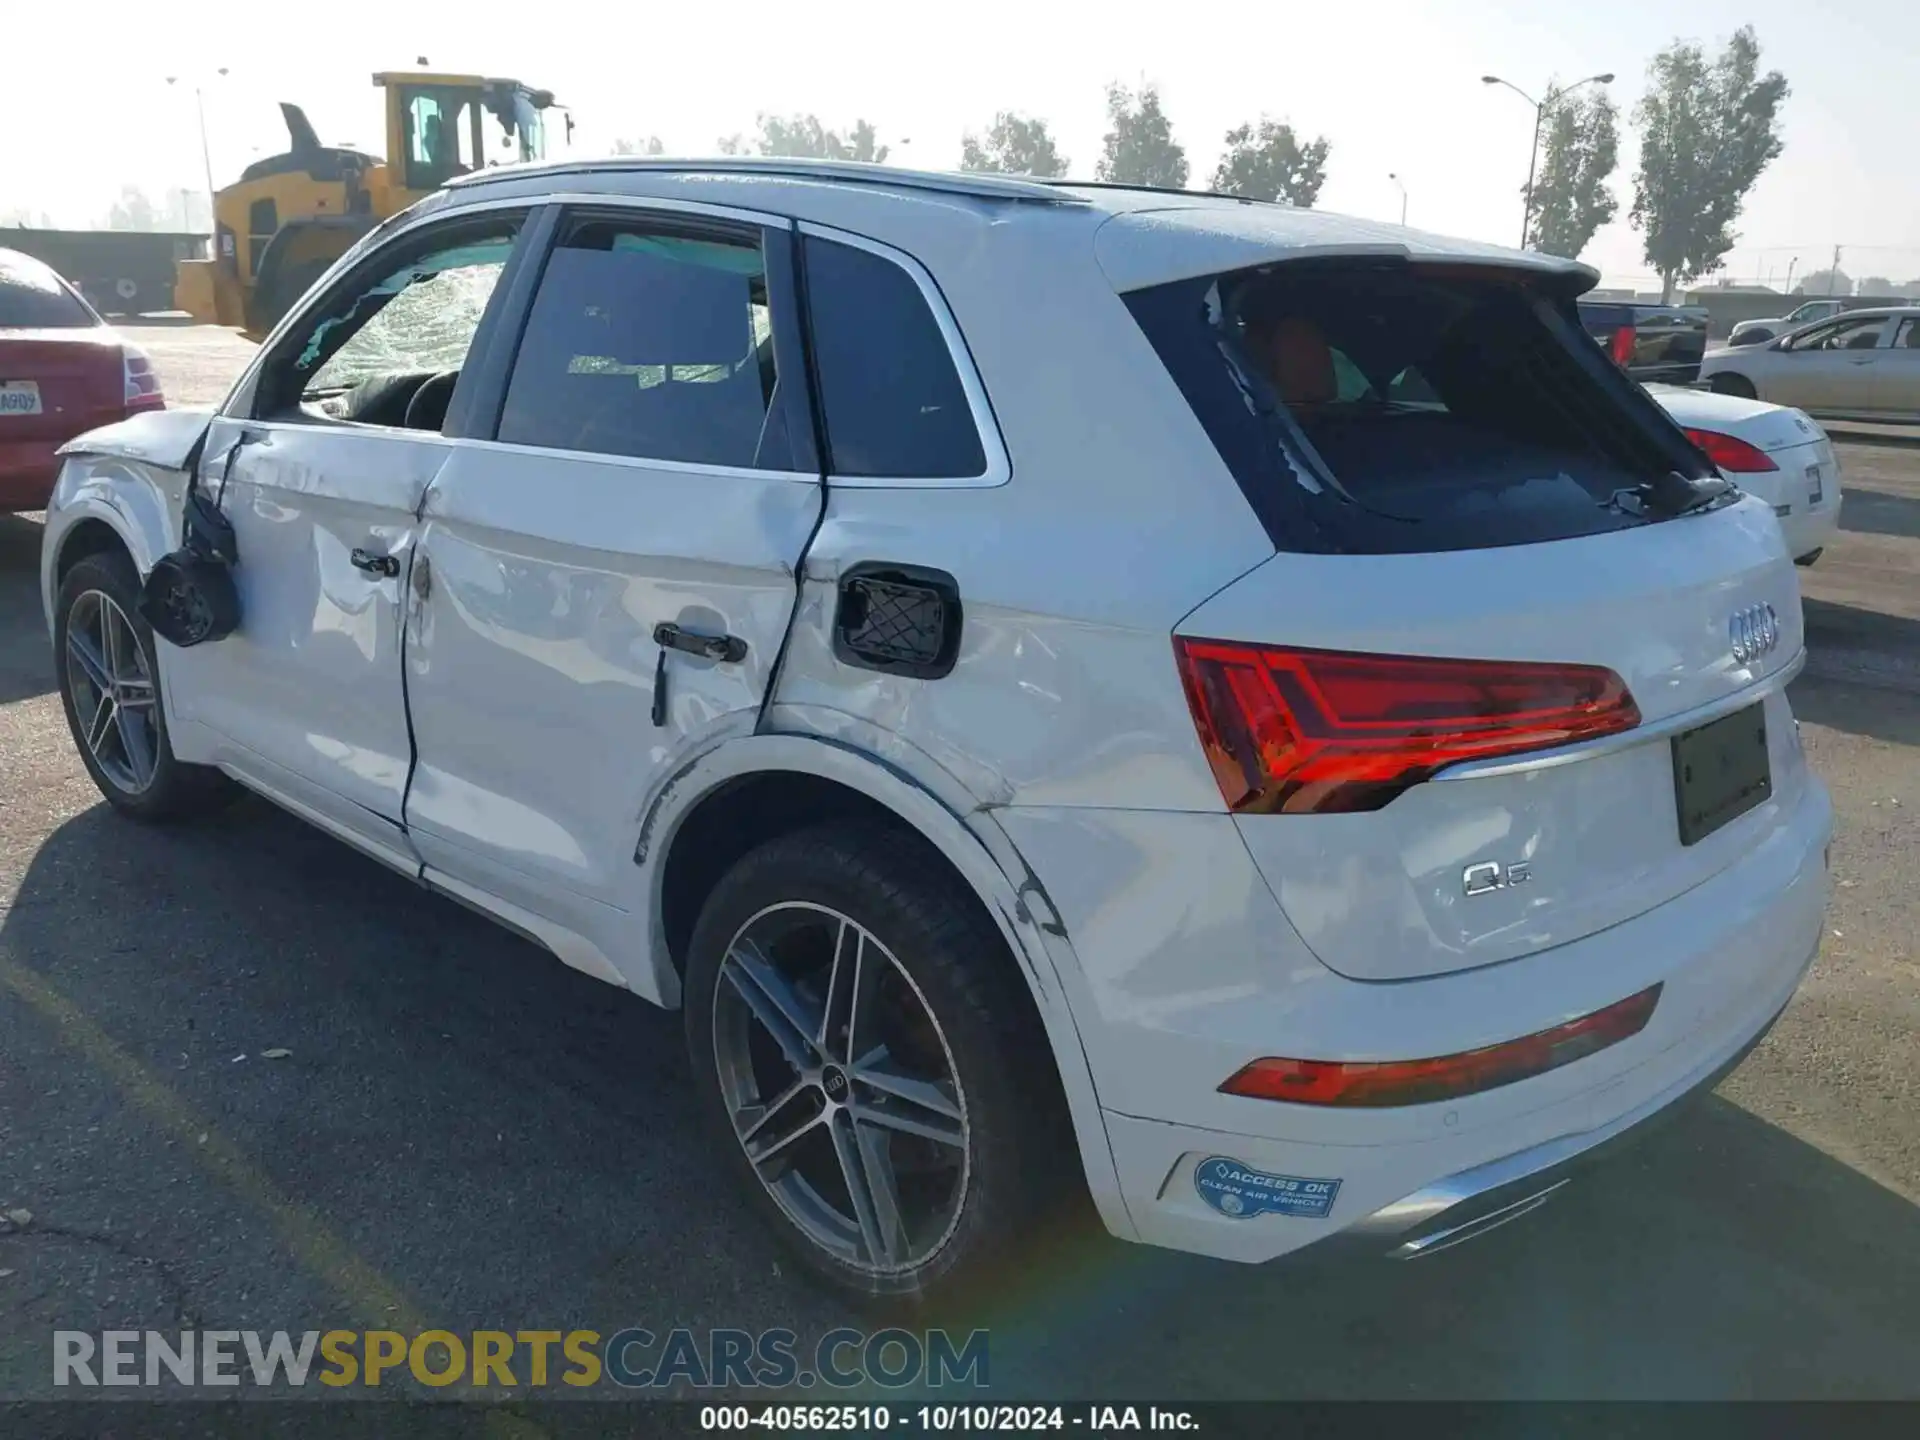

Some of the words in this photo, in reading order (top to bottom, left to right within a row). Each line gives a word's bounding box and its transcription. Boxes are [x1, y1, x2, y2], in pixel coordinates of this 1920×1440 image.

[1463, 861, 1532, 895] Q5
[1201, 1179, 1242, 1194] CLEAN
[1245, 1191, 1268, 1201] AIR
[1273, 1195, 1326, 1207] VEHICLE
[1228, 1170, 1299, 1191] ACCESS
[1304, 1183, 1332, 1194] OK
